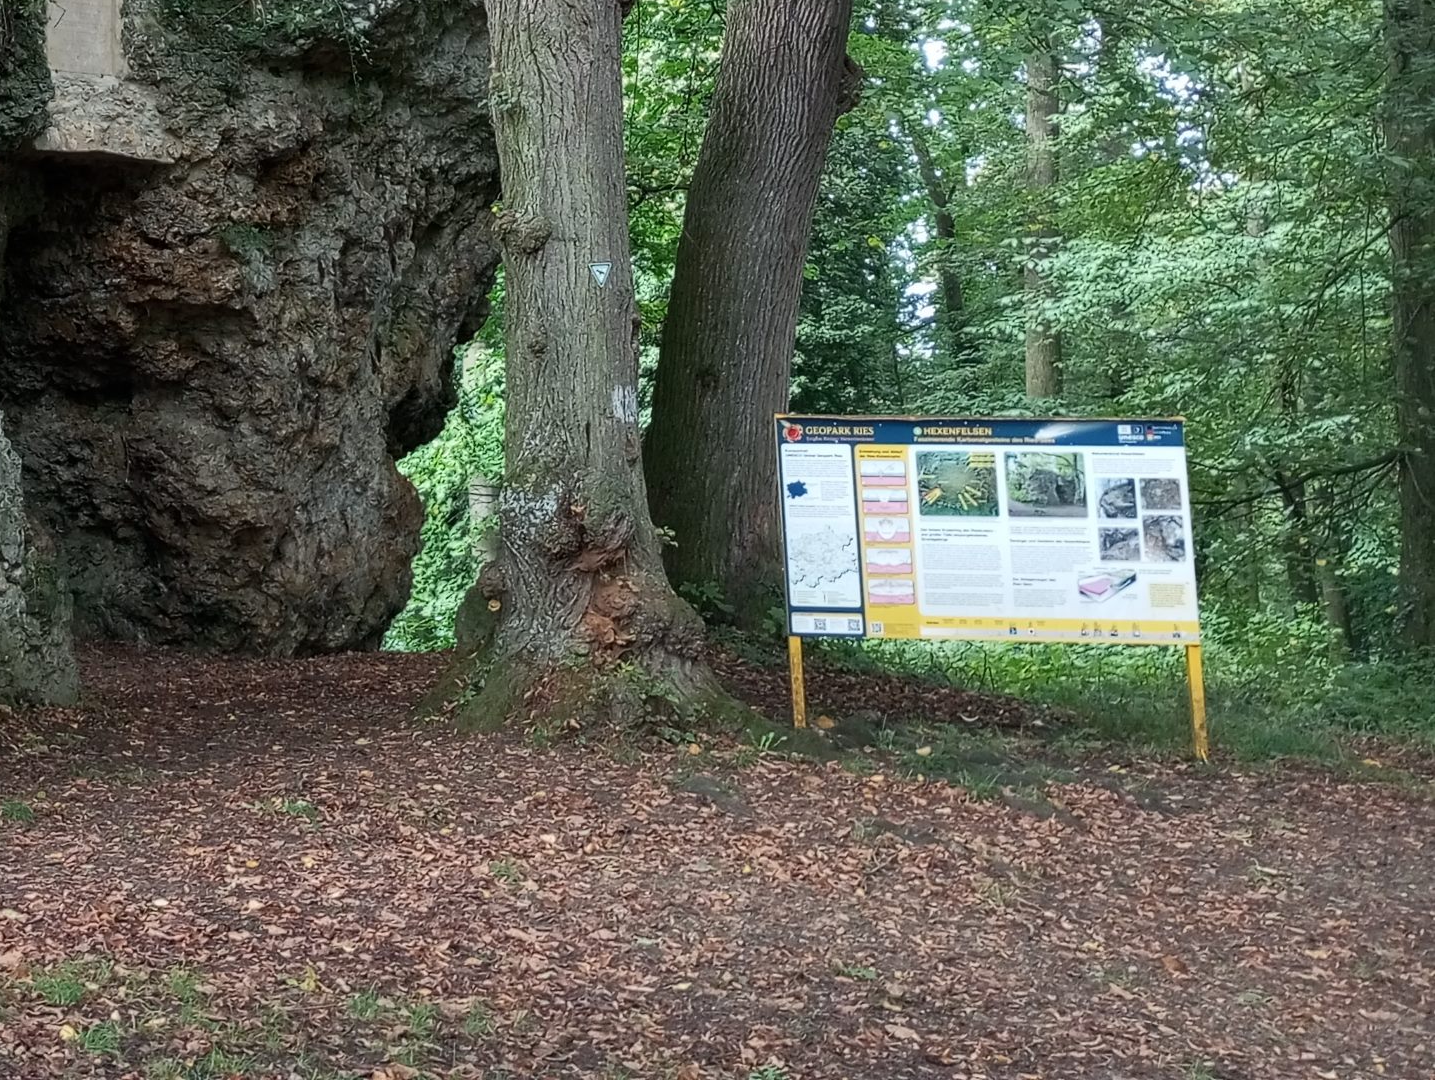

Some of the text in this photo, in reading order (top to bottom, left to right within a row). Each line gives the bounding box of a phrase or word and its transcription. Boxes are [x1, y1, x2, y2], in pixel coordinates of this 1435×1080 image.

[805, 426, 874, 435] GEOPARK RIES
[923, 427, 992, 436] HEXENFELSEN
